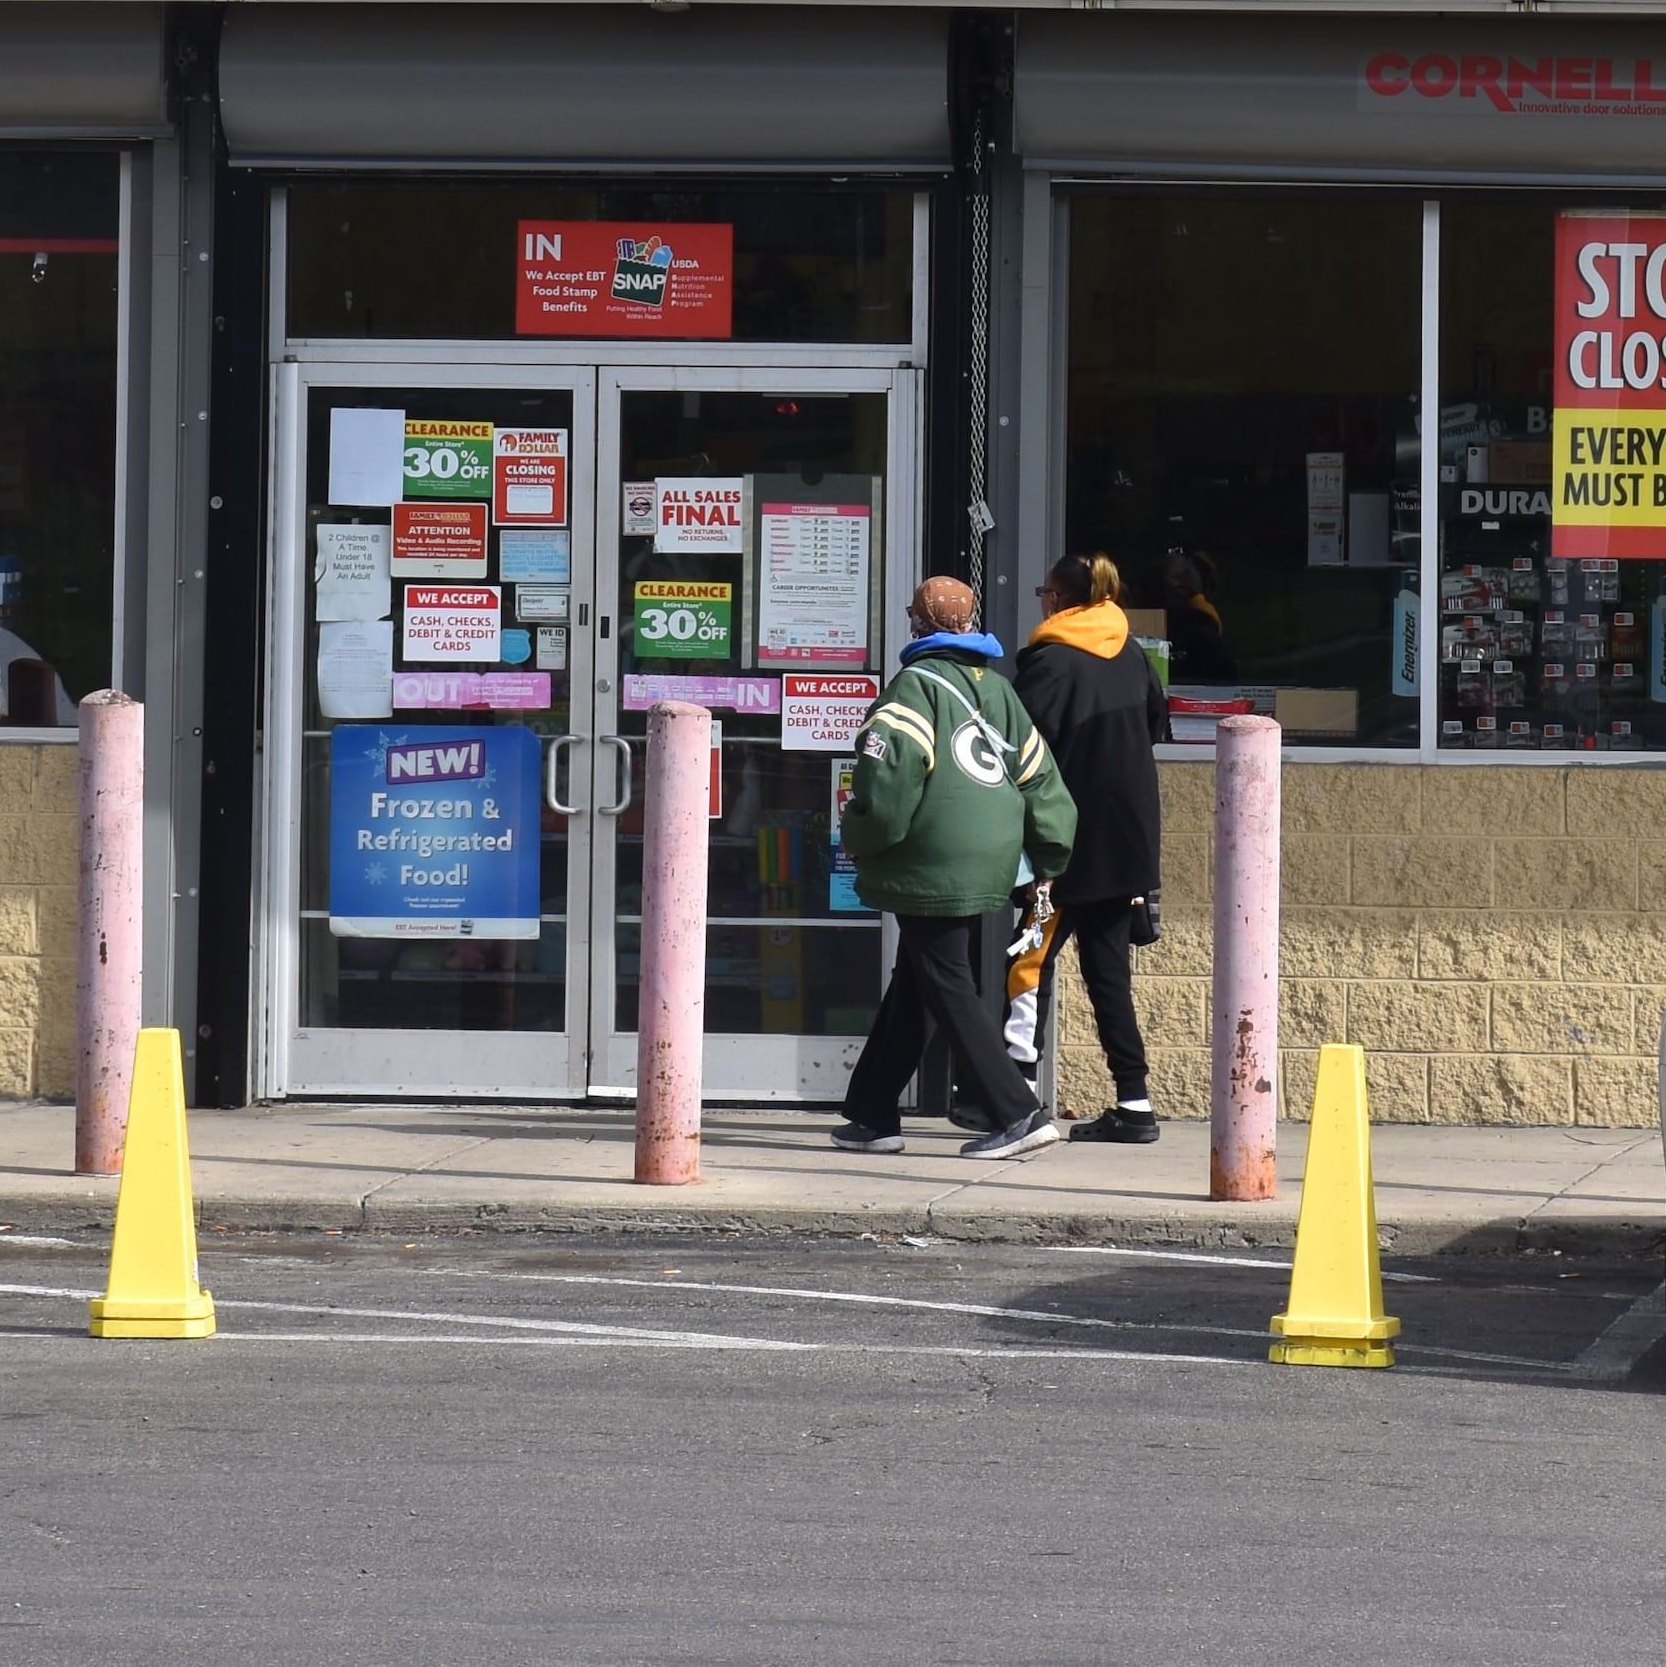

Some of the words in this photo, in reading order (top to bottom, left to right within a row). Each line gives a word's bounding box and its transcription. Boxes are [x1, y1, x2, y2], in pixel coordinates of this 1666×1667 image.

[1519, 101, 1581, 115] Innovative
[1583, 102, 1610, 116] door
[525, 233, 562, 261] IN
[671, 259, 700, 269] USDA
[525, 270, 543, 281] We
[545, 270, 584, 284] Accept
[586, 271, 607, 282] EBT
[613, 273, 667, 291] SNAP
[533, 286, 560, 297] Food
[562, 286, 598, 299] Stamp
[671, 291, 713, 299] Assistance
[542, 301, 588, 313] Benefits
[671, 299, 705, 308] Program
[405, 422, 489, 437] CLEARANCE
[518, 432, 560, 444] FAMILY
[518, 444, 559, 454] DOLLAR
[460, 465, 490, 479] OFF
[505, 465, 556, 475] CLOSING
[1563, 472, 1644, 507] MUST
[661, 490, 690, 503] ALL
[694, 490, 741, 503] SALES
[1460, 489, 1552, 515] DURA
[662, 505, 741, 526] FINAL
[408, 525, 471, 535] ATTENTION
[335, 534, 369, 542] Children
[370, 534, 380, 543] @
[396, 536, 418, 544] Video
[425, 537, 445, 545] Audio
[446, 537, 482, 546] Recording
[335, 553, 361, 561] Under
[639, 584, 727, 598] CLEARANCE
[417, 592, 439, 604] WE
[440, 593, 490, 605] ACCEPT
[662, 601, 681, 609] Entire
[410, 616, 444, 627] CASH,
[447, 617, 495, 628] CHECKS,
[408, 628, 441, 638] DEBIT
[444, 629, 452, 639] &
[455, 629, 496, 639] CREDIT
[539, 629, 554, 637] WE
[698, 626, 728, 641] OFF
[432, 641, 471, 651] CARDS
[1401, 612, 1418, 684] Energizer
[399, 677, 462, 702] OUT
[795, 681, 817, 693] WE
[819, 682, 868, 694] ACCEPT
[737, 684, 770, 707] IN
[788, 705, 823, 716] CASH,
[787, 717, 820, 728] DEBIT
[823, 718, 831, 728] &
[834, 718, 862, 728] CRED
[811, 730, 850, 741] CARDS
[951, 719, 1006, 788] G
[390, 742, 481, 779] NEW!
[370, 792, 473, 820] Frozen
[482, 797, 501, 820] &
[357, 828, 514, 859] Refrigerated
[400, 862, 470, 887] Food!
